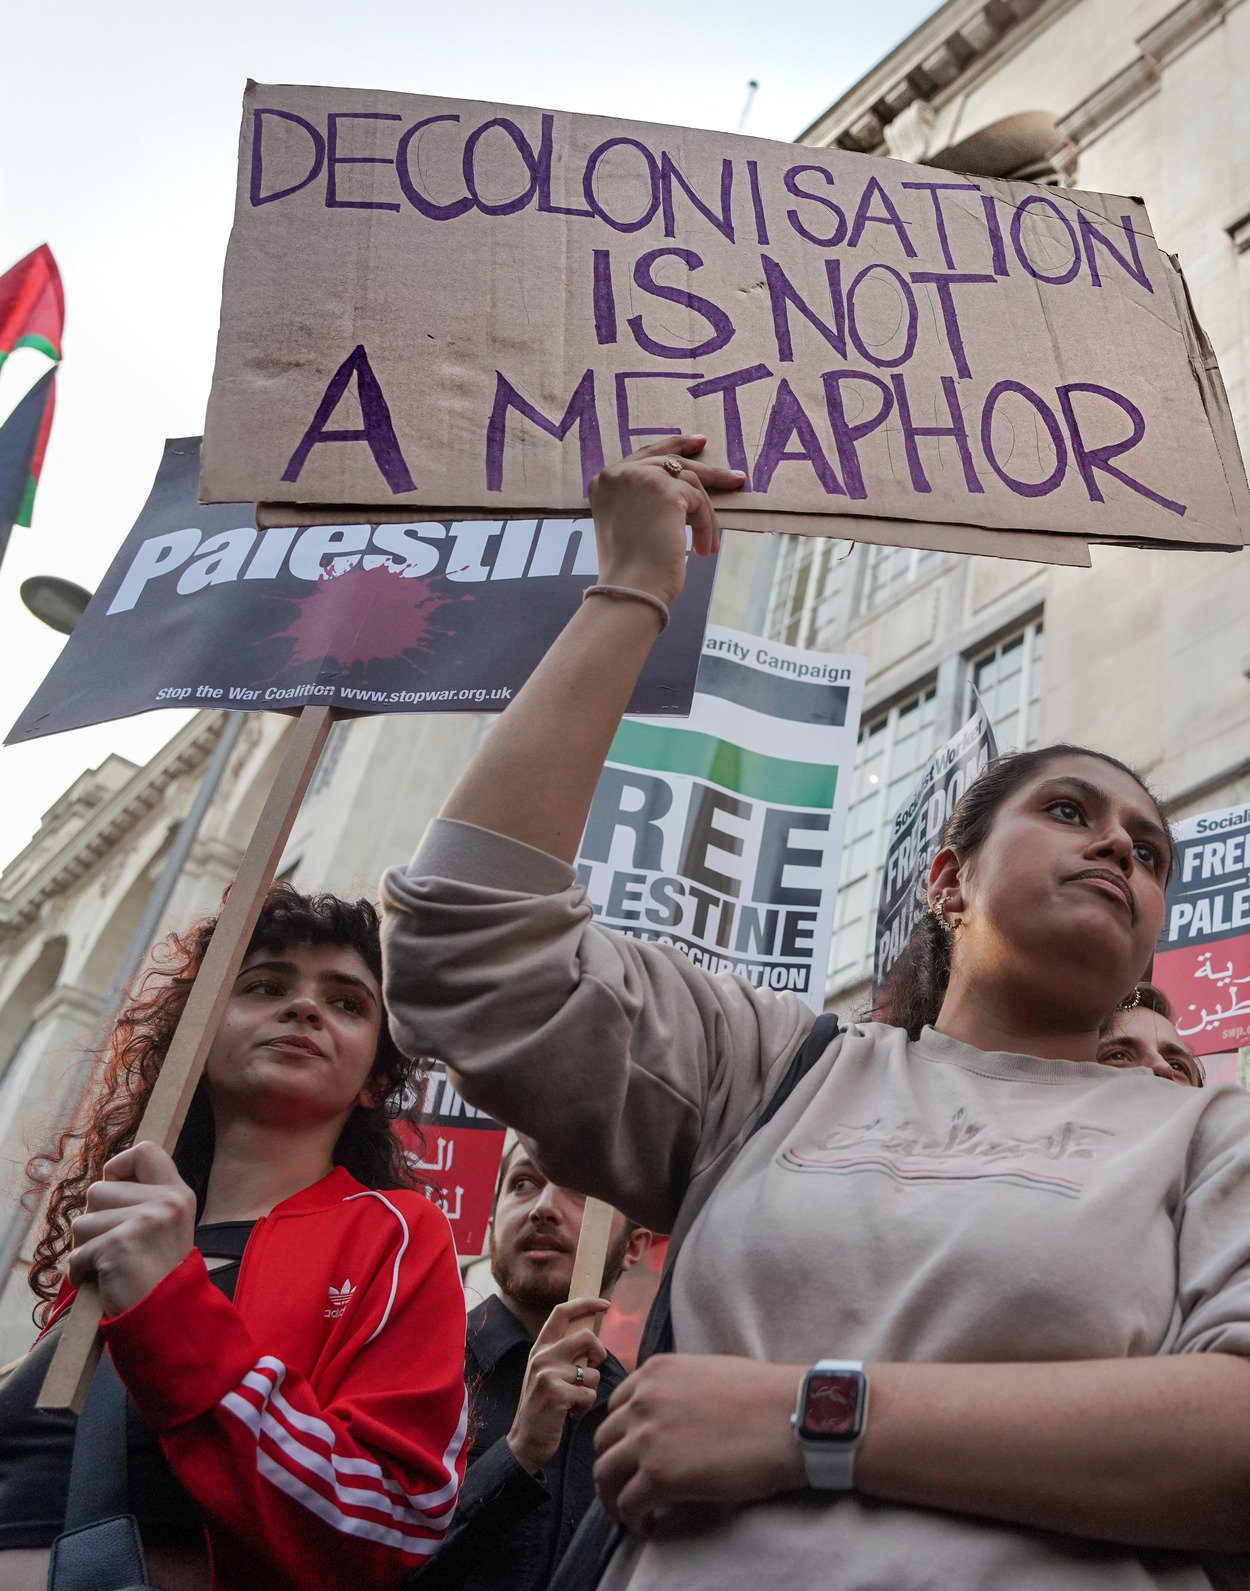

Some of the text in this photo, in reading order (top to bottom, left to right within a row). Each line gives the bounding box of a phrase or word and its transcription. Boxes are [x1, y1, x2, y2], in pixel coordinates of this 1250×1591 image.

[250, 108, 1154, 293] DECOLONISATION
[592, 247, 998, 379] IS NOT
[280, 344, 1188, 516] A METAPHOR
[106, 518, 692, 616] Palestin
[156, 684, 513, 703] Stop the War Coalition www.stopwar.org.uk
[706, 638, 851, 683] arity Campaign
[579, 764, 832, 907] REE
[577, 862, 818, 958] LESTINE
